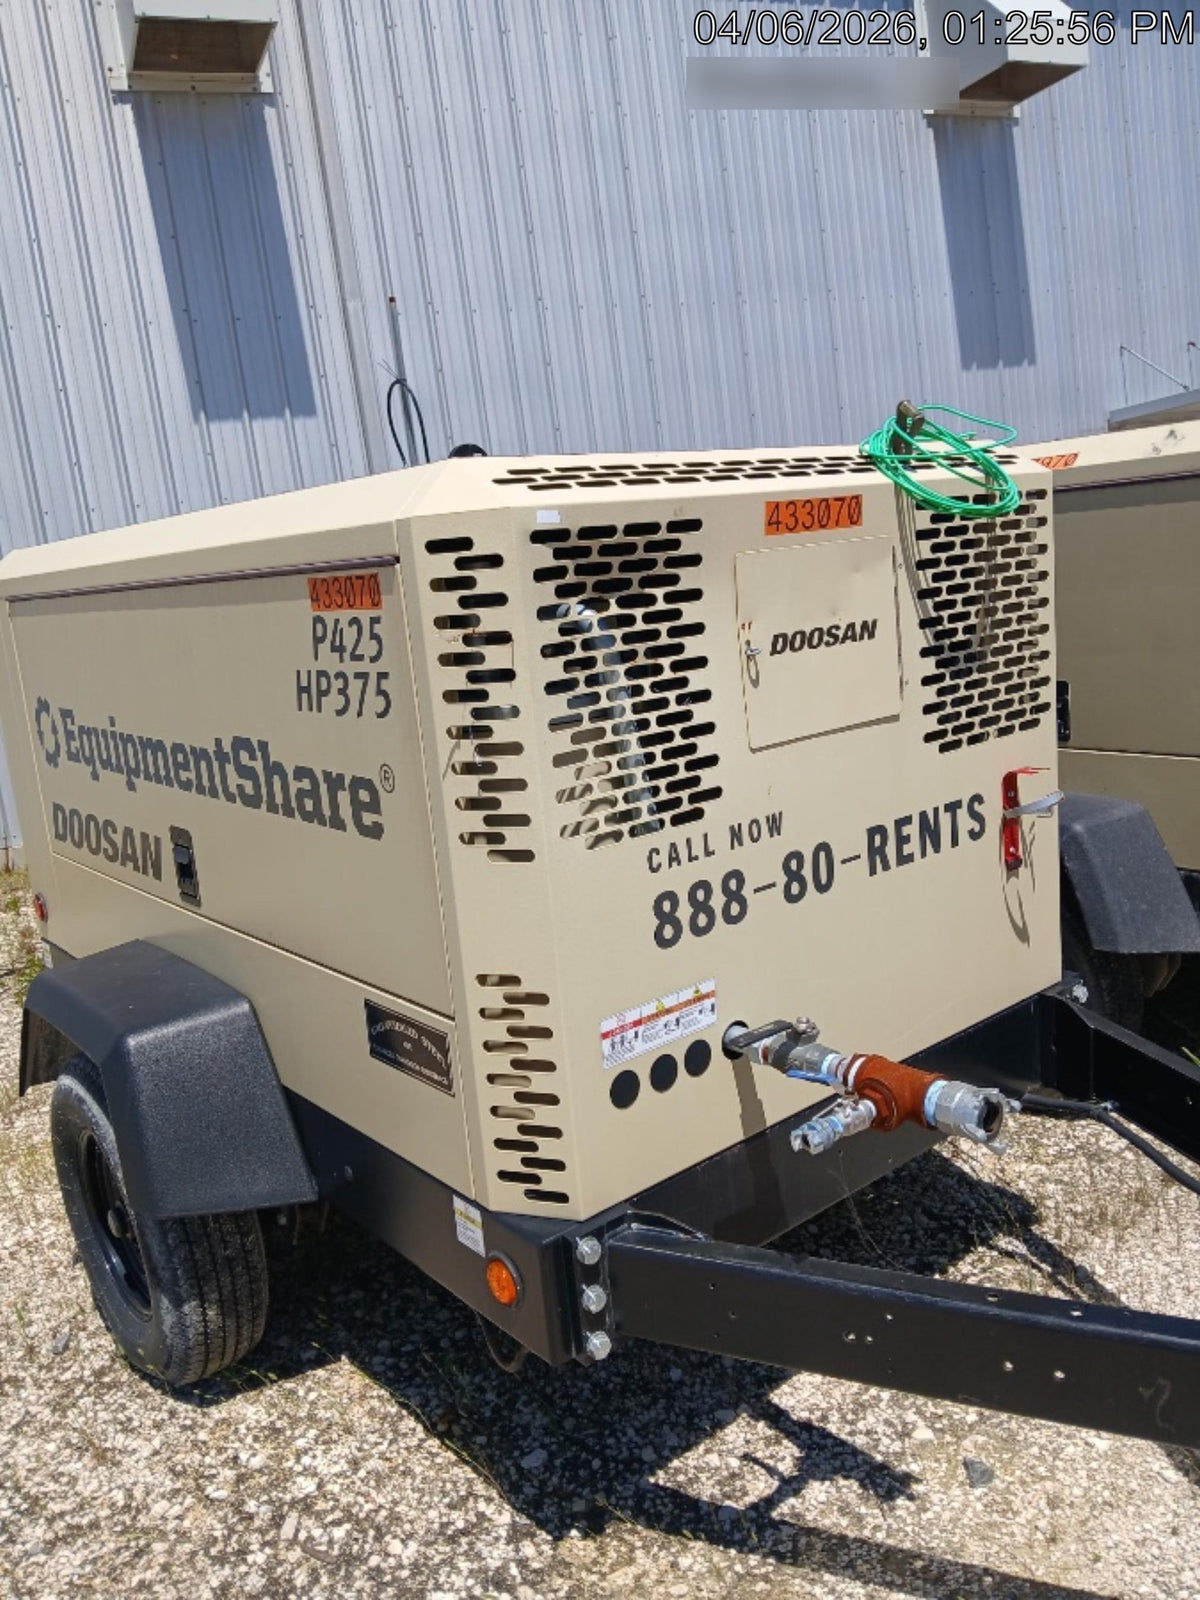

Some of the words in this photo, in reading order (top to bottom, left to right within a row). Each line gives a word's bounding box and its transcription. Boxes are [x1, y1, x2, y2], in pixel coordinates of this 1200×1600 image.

[767, 495, 861, 532] 433070
[310, 574, 381, 609] 433070
[312, 614, 384, 664] P425
[769, 618, 878, 657] DOOSAN
[296, 669, 392, 719] HP375
[53, 802, 163, 883] DOOSAN
[647, 832, 716, 874] CALL
[728, 811, 784, 851] NOW
[652, 793, 987, 949] 888-80-RENTS
